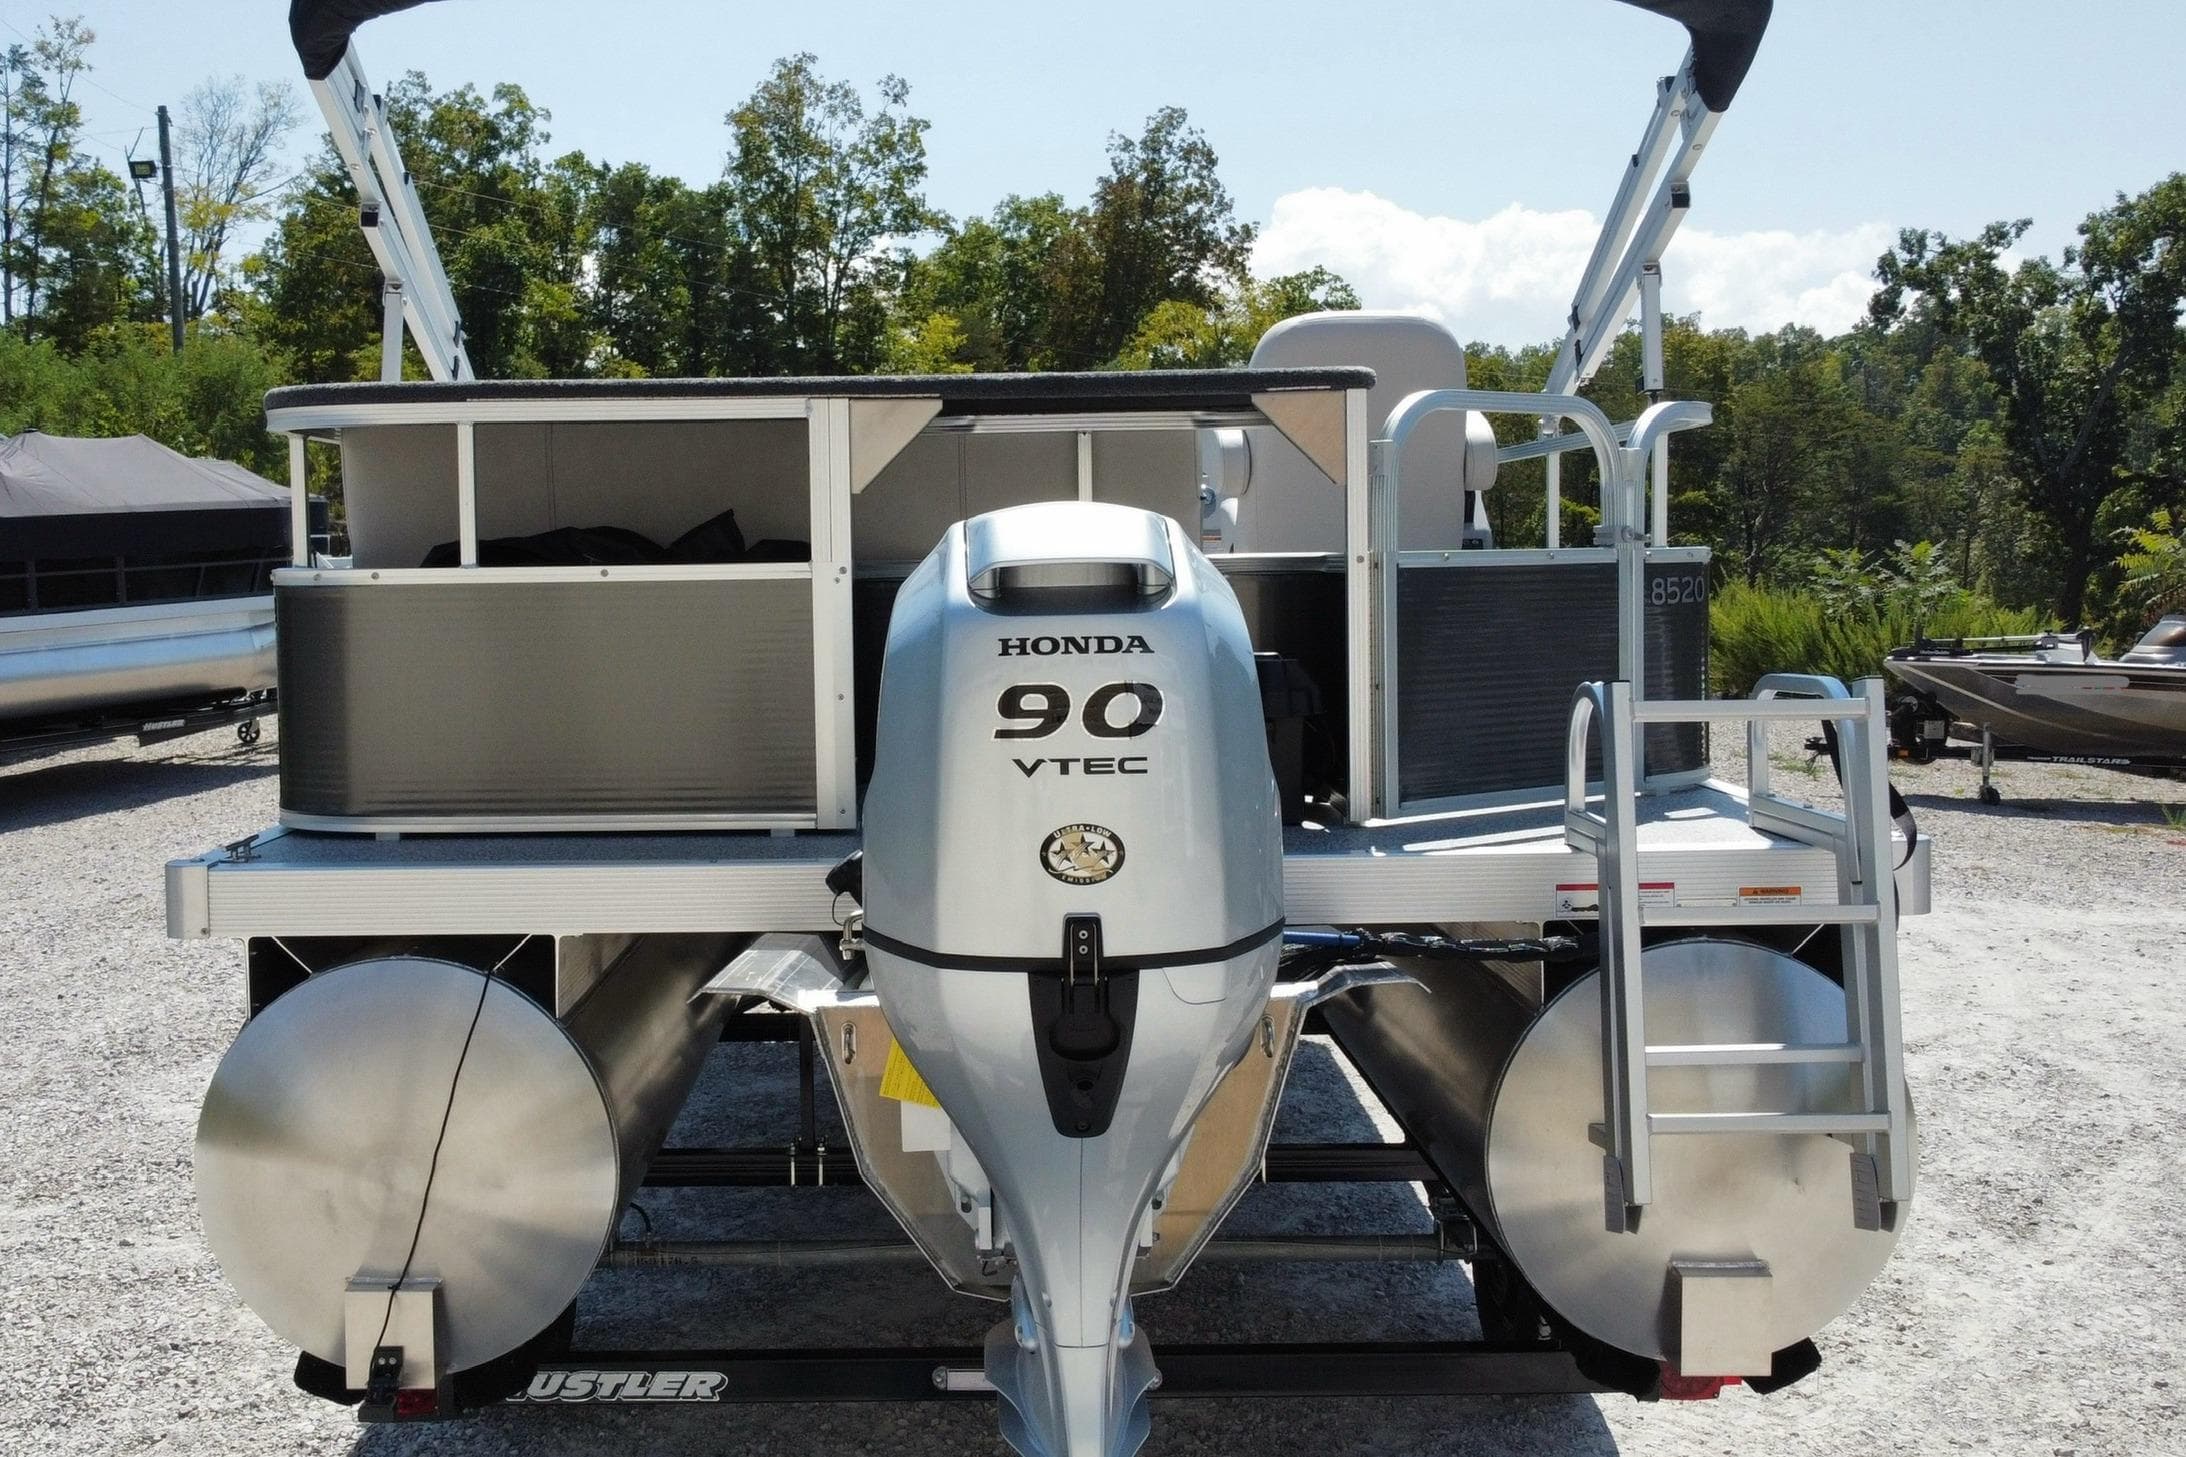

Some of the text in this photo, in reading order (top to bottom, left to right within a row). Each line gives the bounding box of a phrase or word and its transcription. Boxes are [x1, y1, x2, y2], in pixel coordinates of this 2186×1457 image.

[1651, 576, 1705, 606] 8520
[997, 635, 1155, 657] HONDA
[992, 681, 1166, 741] 90
[1011, 756, 1148, 778] VTEC
[2052, 755, 2131, 765] TRAILSTAR
[506, 1371, 729, 1401] USTLER
